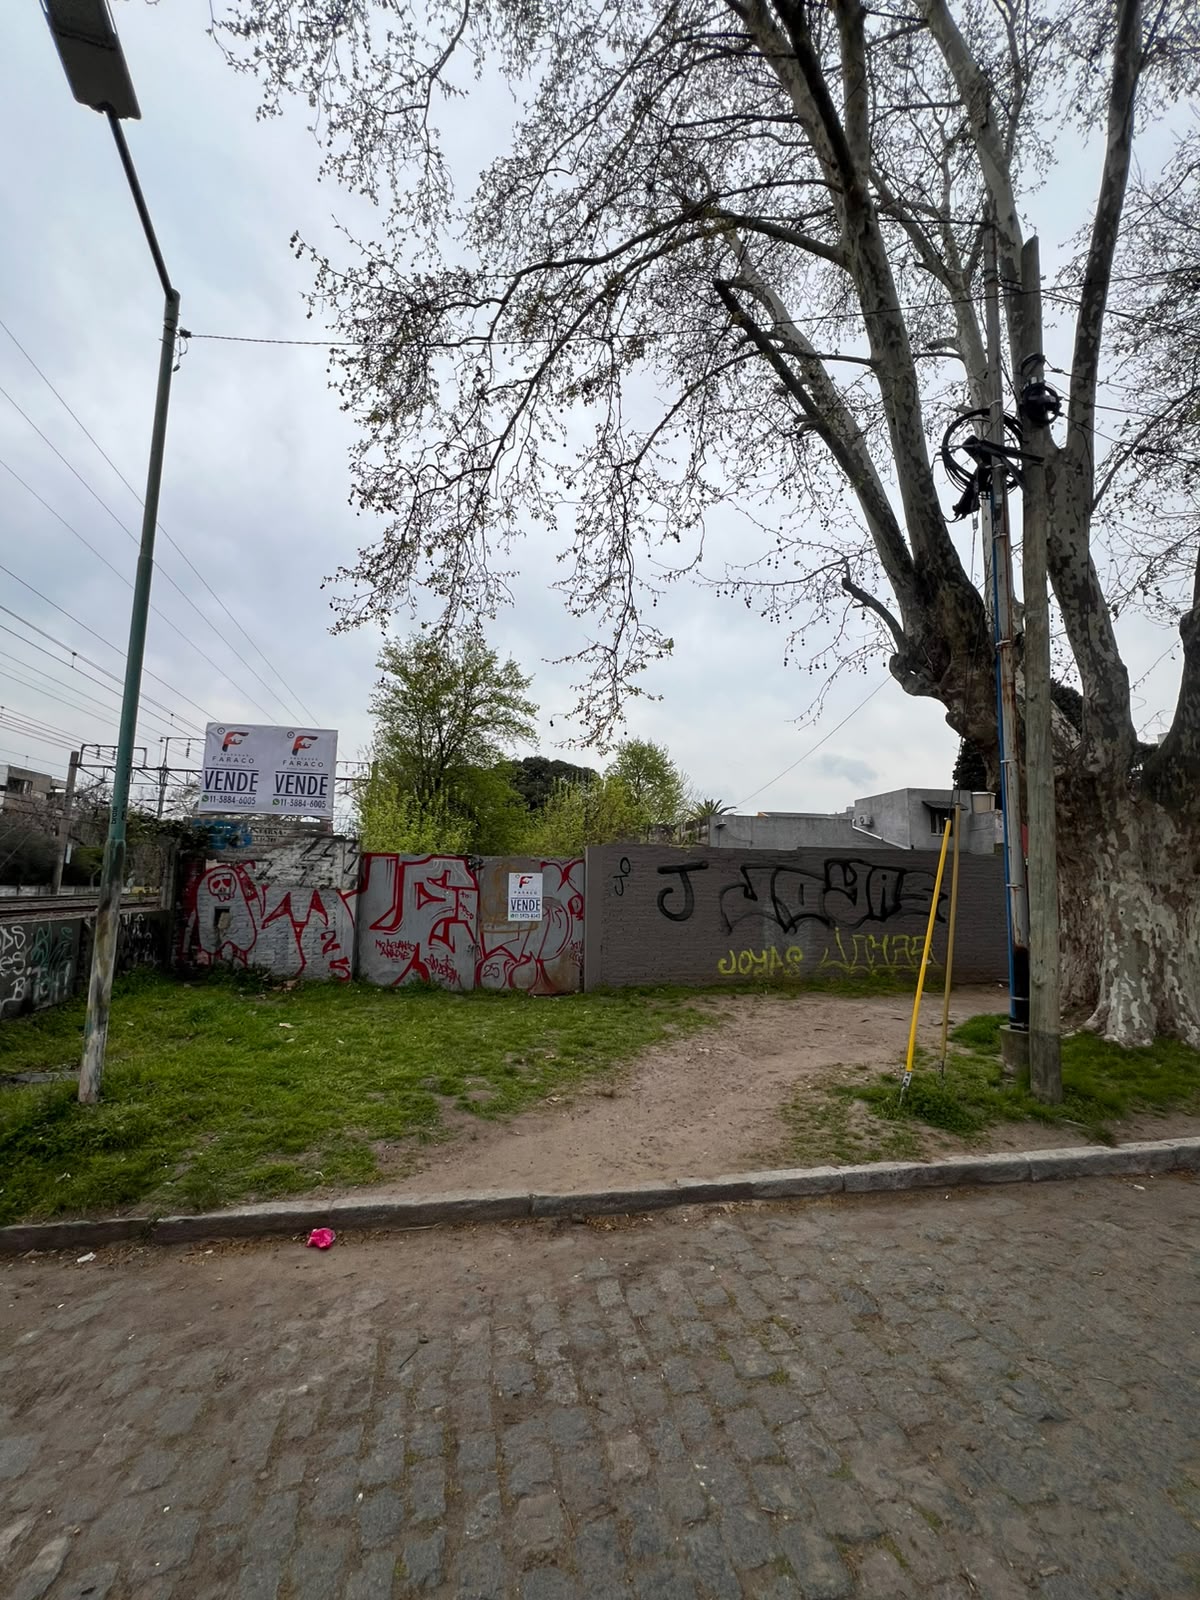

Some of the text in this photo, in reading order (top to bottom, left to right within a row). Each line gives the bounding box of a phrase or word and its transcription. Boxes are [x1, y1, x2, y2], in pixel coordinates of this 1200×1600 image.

[212, 755, 255, 764] FARACO
[282, 759, 324, 768] FARACO
[204, 770, 259, 792] VENDE
[275, 774, 328, 795] VENDE
[511, 899, 541, 911] VENDE
